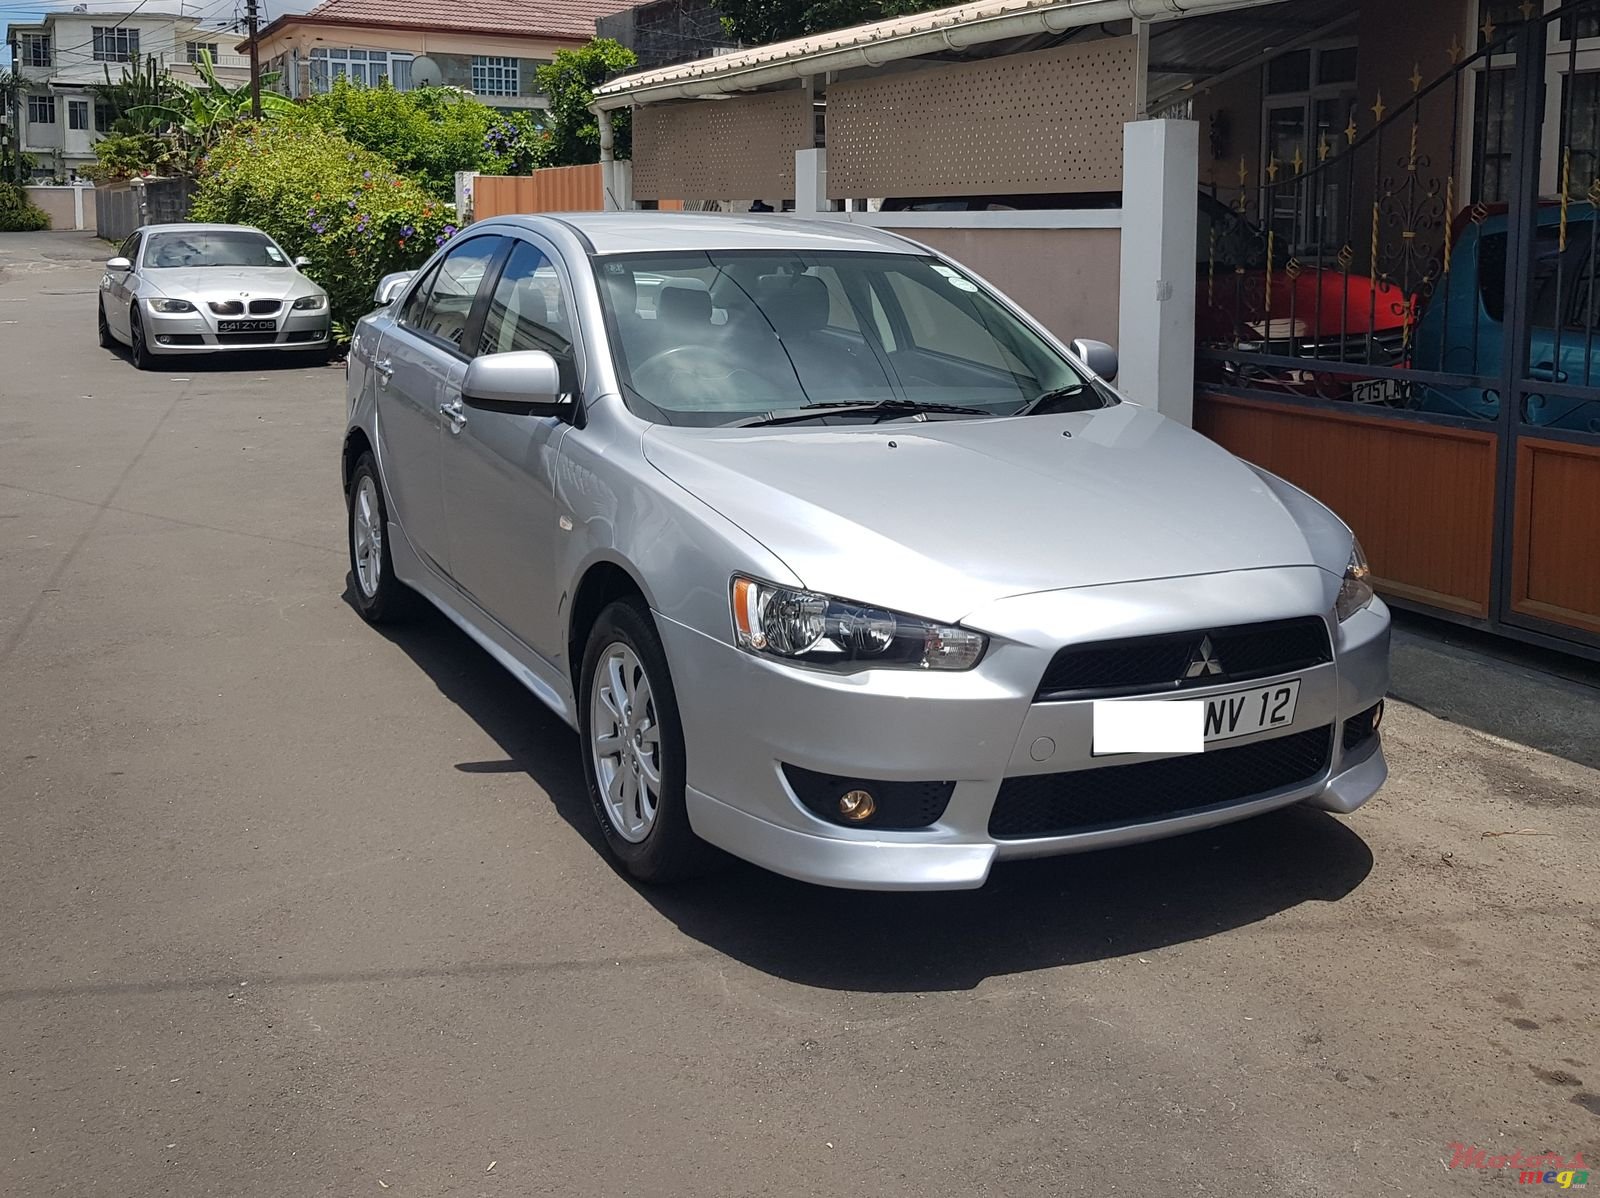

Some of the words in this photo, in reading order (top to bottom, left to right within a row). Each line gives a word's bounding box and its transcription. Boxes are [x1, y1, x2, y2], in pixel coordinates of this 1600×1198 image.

[219, 322, 240, 330] 441
[242, 321, 258, 330] ZY
[259, 321, 275, 329] 09
[1203, 696, 1246, 736] NV
[1259, 687, 1291, 726] 12
